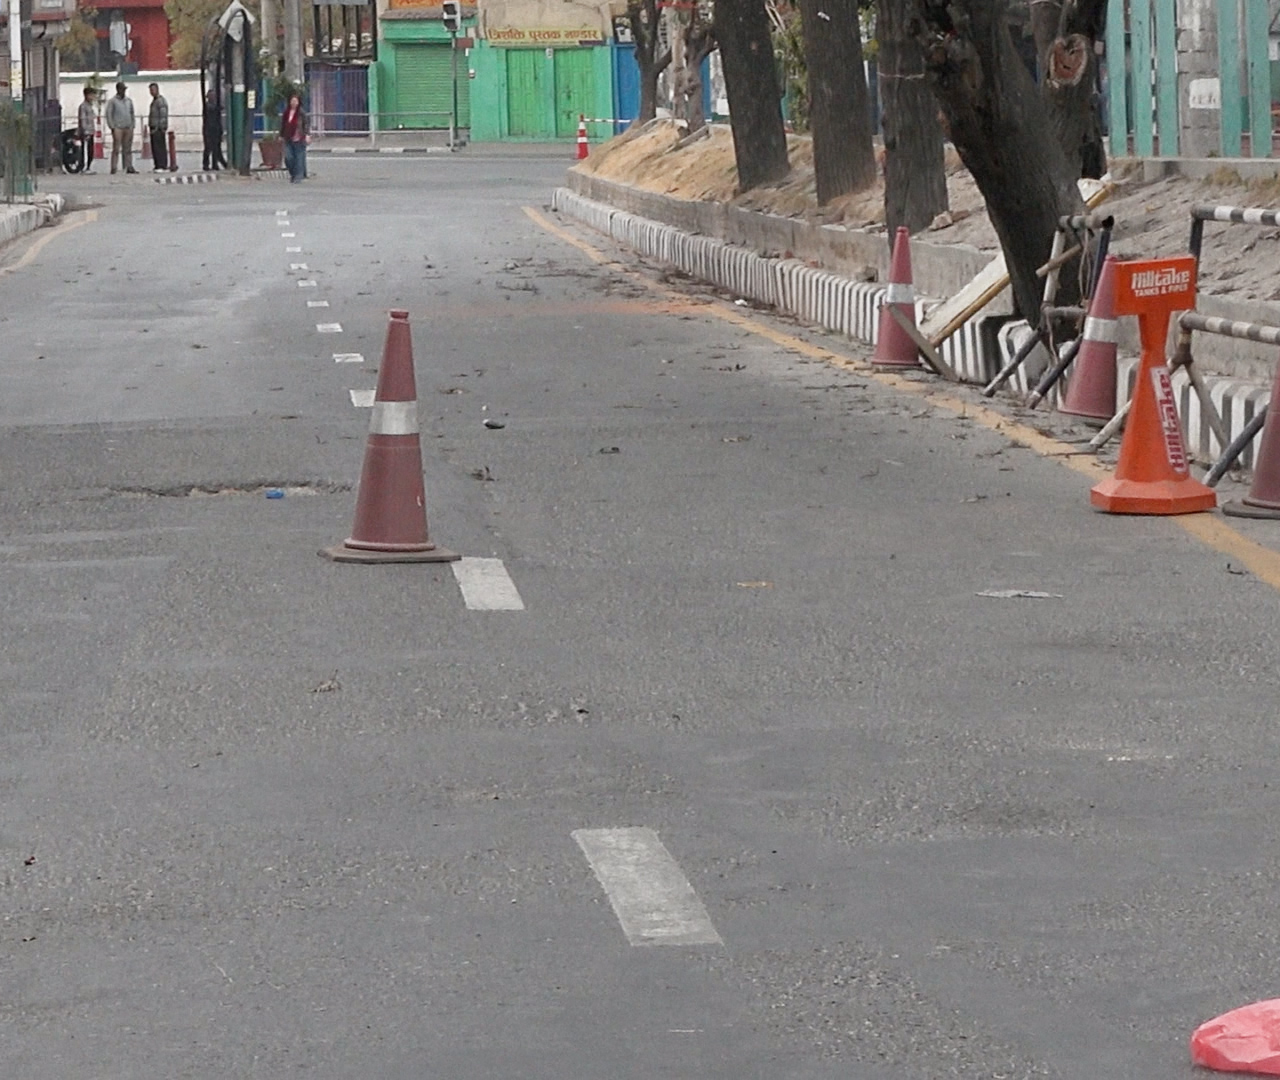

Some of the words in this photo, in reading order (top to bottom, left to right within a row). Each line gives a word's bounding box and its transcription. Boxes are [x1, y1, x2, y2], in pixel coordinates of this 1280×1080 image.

[529, 30, 561, 41] पुस्तक
[1131, 267, 1190, 290] Hilltake
[1134, 287, 1160, 297] TANKS
